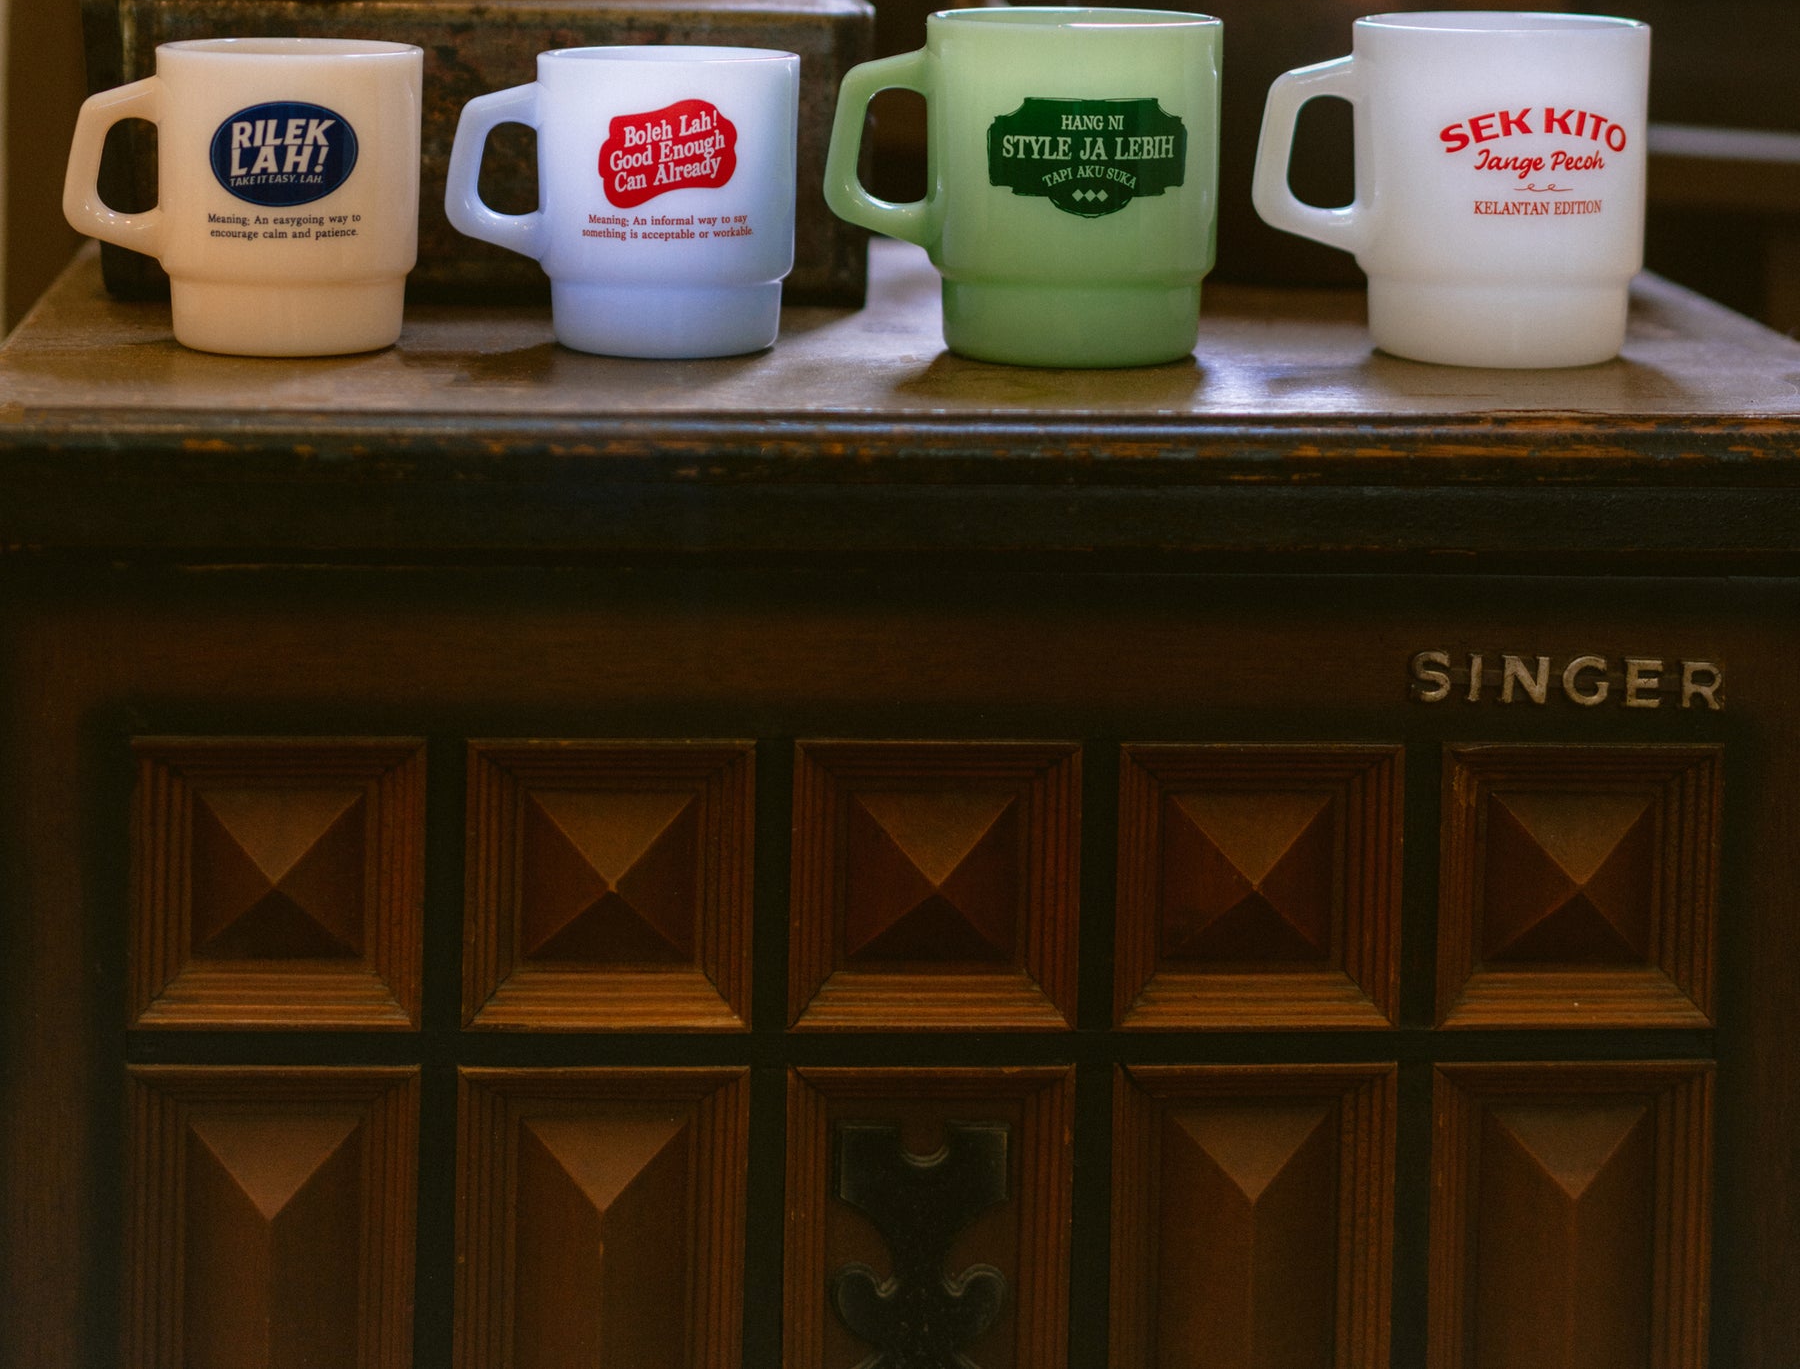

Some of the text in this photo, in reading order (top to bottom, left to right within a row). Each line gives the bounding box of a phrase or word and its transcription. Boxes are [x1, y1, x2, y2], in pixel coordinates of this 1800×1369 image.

[232, 119, 336, 149] RILEK
[624, 110, 717, 148] Boleh Lah!
[1061, 115, 1124, 130] HANG NI
[1439, 107, 1626, 153] SEK KITO
[610, 130, 725, 172] Good Enough
[1003, 135, 1174, 160] STYLE JA LEBIH
[230, 145, 329, 176] LAH!
[230, 176, 255, 186] TAKE
[257, 176, 267, 184] IT
[615, 156, 722, 193] Can Already
[1042, 165, 1136, 189] TAPI AKU SUKA
[208, 213, 250, 226] Meaning:
[254, 216, 268, 224] An
[274, 215, 324, 226] easygoing
[329, 215, 348, 223] way
[1473, 200, 1602, 215] KELANTAN EDITION
[588, 214, 629, 227] Meaning:
[633, 216, 647, 225] An
[651, 215, 693, 225] informal
[734, 214, 747, 224] say
[210, 229, 258, 240] encourage
[263, 229, 288, 239] calm
[292, 229, 311, 238] and
[582, 228, 626, 241] something
[630, 229, 638, 239] is
[642, 229, 695, 241] acceptable
[1410, 651, 1722, 711] SINGER
